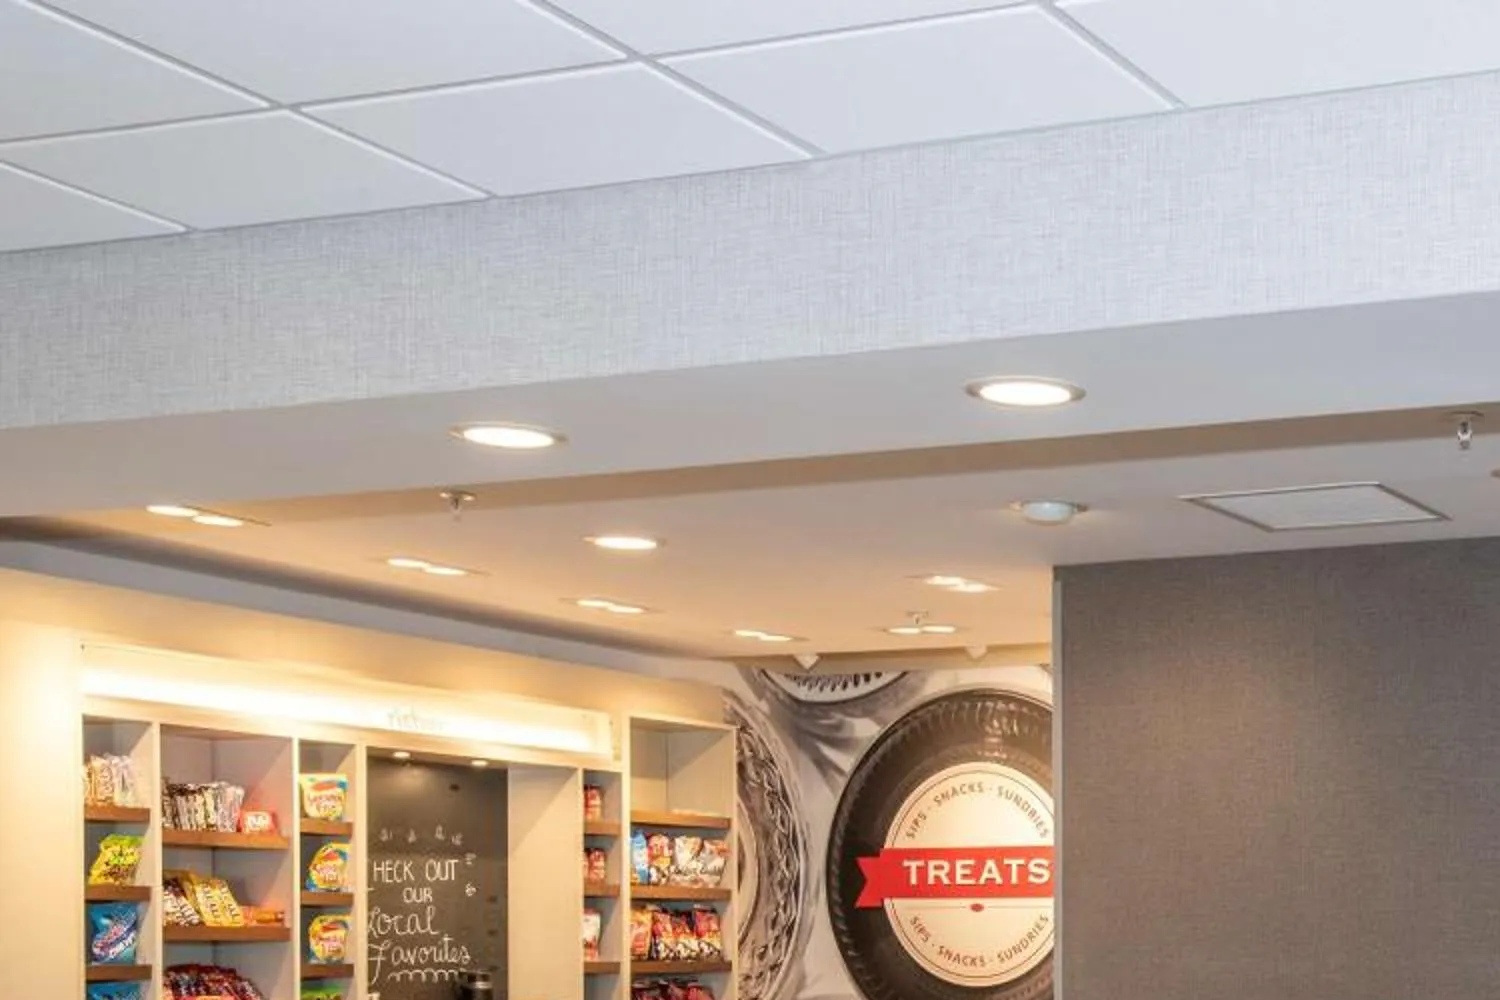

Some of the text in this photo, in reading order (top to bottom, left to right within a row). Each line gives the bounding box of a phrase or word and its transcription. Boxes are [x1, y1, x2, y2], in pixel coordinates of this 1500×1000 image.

[905, 782, 1049, 839] SIPS SNACKS SUNDRIES
[368, 859, 415, 884] HECK
[425, 858, 460, 882] OUT
[902, 857, 1052, 886] TREATS
[402, 887, 433, 903] OUR
[909, 913, 1050, 968] SIPS SNACKS SUNDRIES
